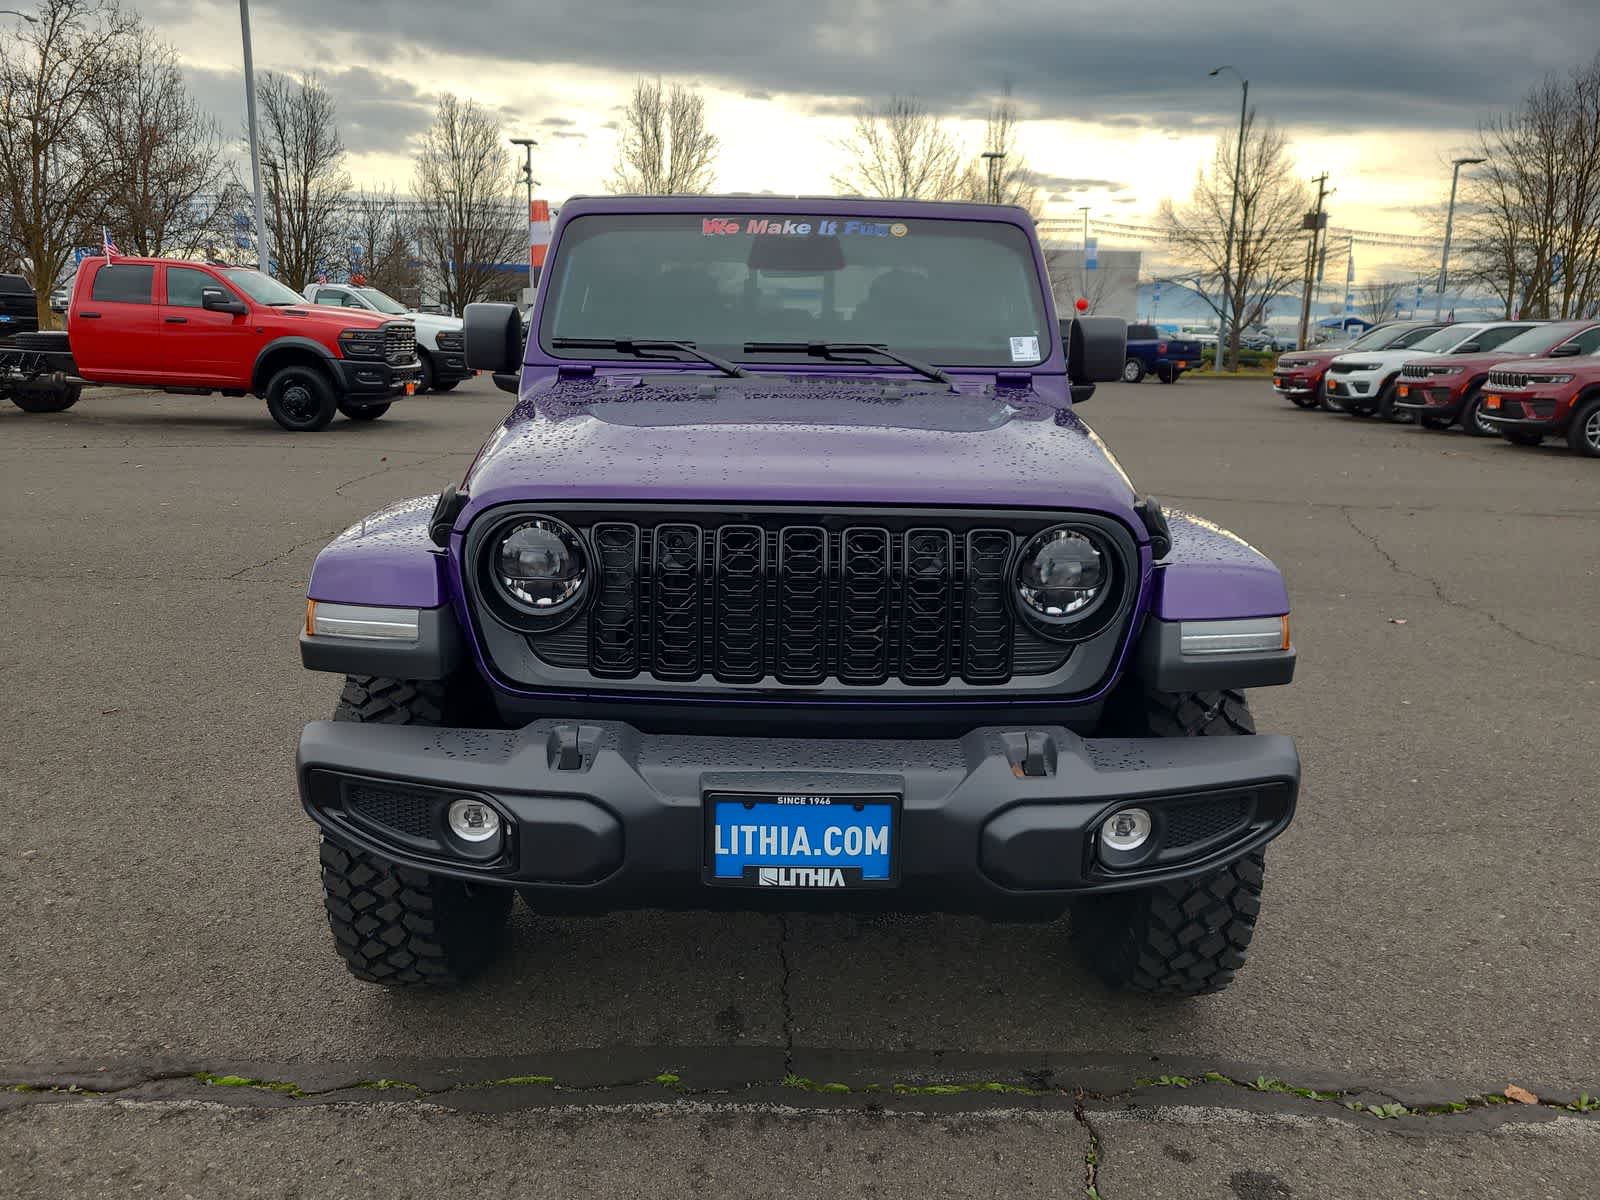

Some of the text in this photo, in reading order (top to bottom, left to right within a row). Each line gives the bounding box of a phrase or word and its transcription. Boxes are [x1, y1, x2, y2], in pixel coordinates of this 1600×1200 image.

[703, 218, 740, 235] We
[747, 219, 811, 235] Make
[818, 220, 838, 235] It
[777, 796, 831, 805] SINCE 1946
[714, 824, 889, 856] LITHIA.COM
[779, 867, 846, 887] LITHIA
